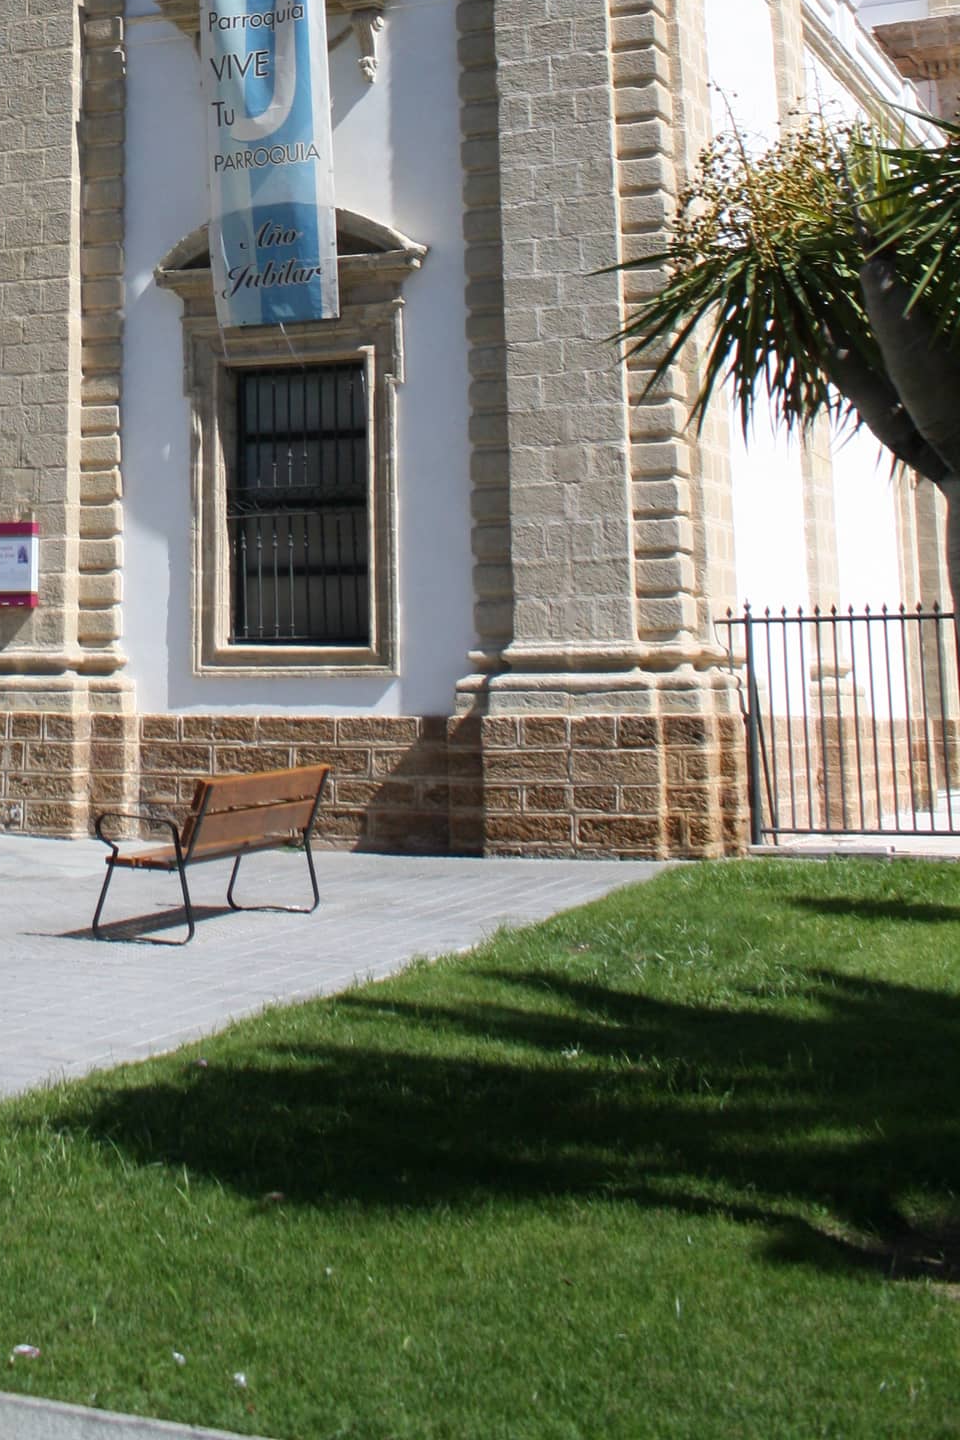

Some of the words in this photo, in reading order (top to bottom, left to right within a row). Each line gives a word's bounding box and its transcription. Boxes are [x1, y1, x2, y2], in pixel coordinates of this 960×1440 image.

[208, 1, 304, 33] Parroquia
[209, 50, 269, 82] VIVE
[211, 101, 236, 128] Tu
[214, 143, 321, 172] PARROQUIA
[240, 221, 304, 250] Año
[222, 258, 322, 300] Jubilar
